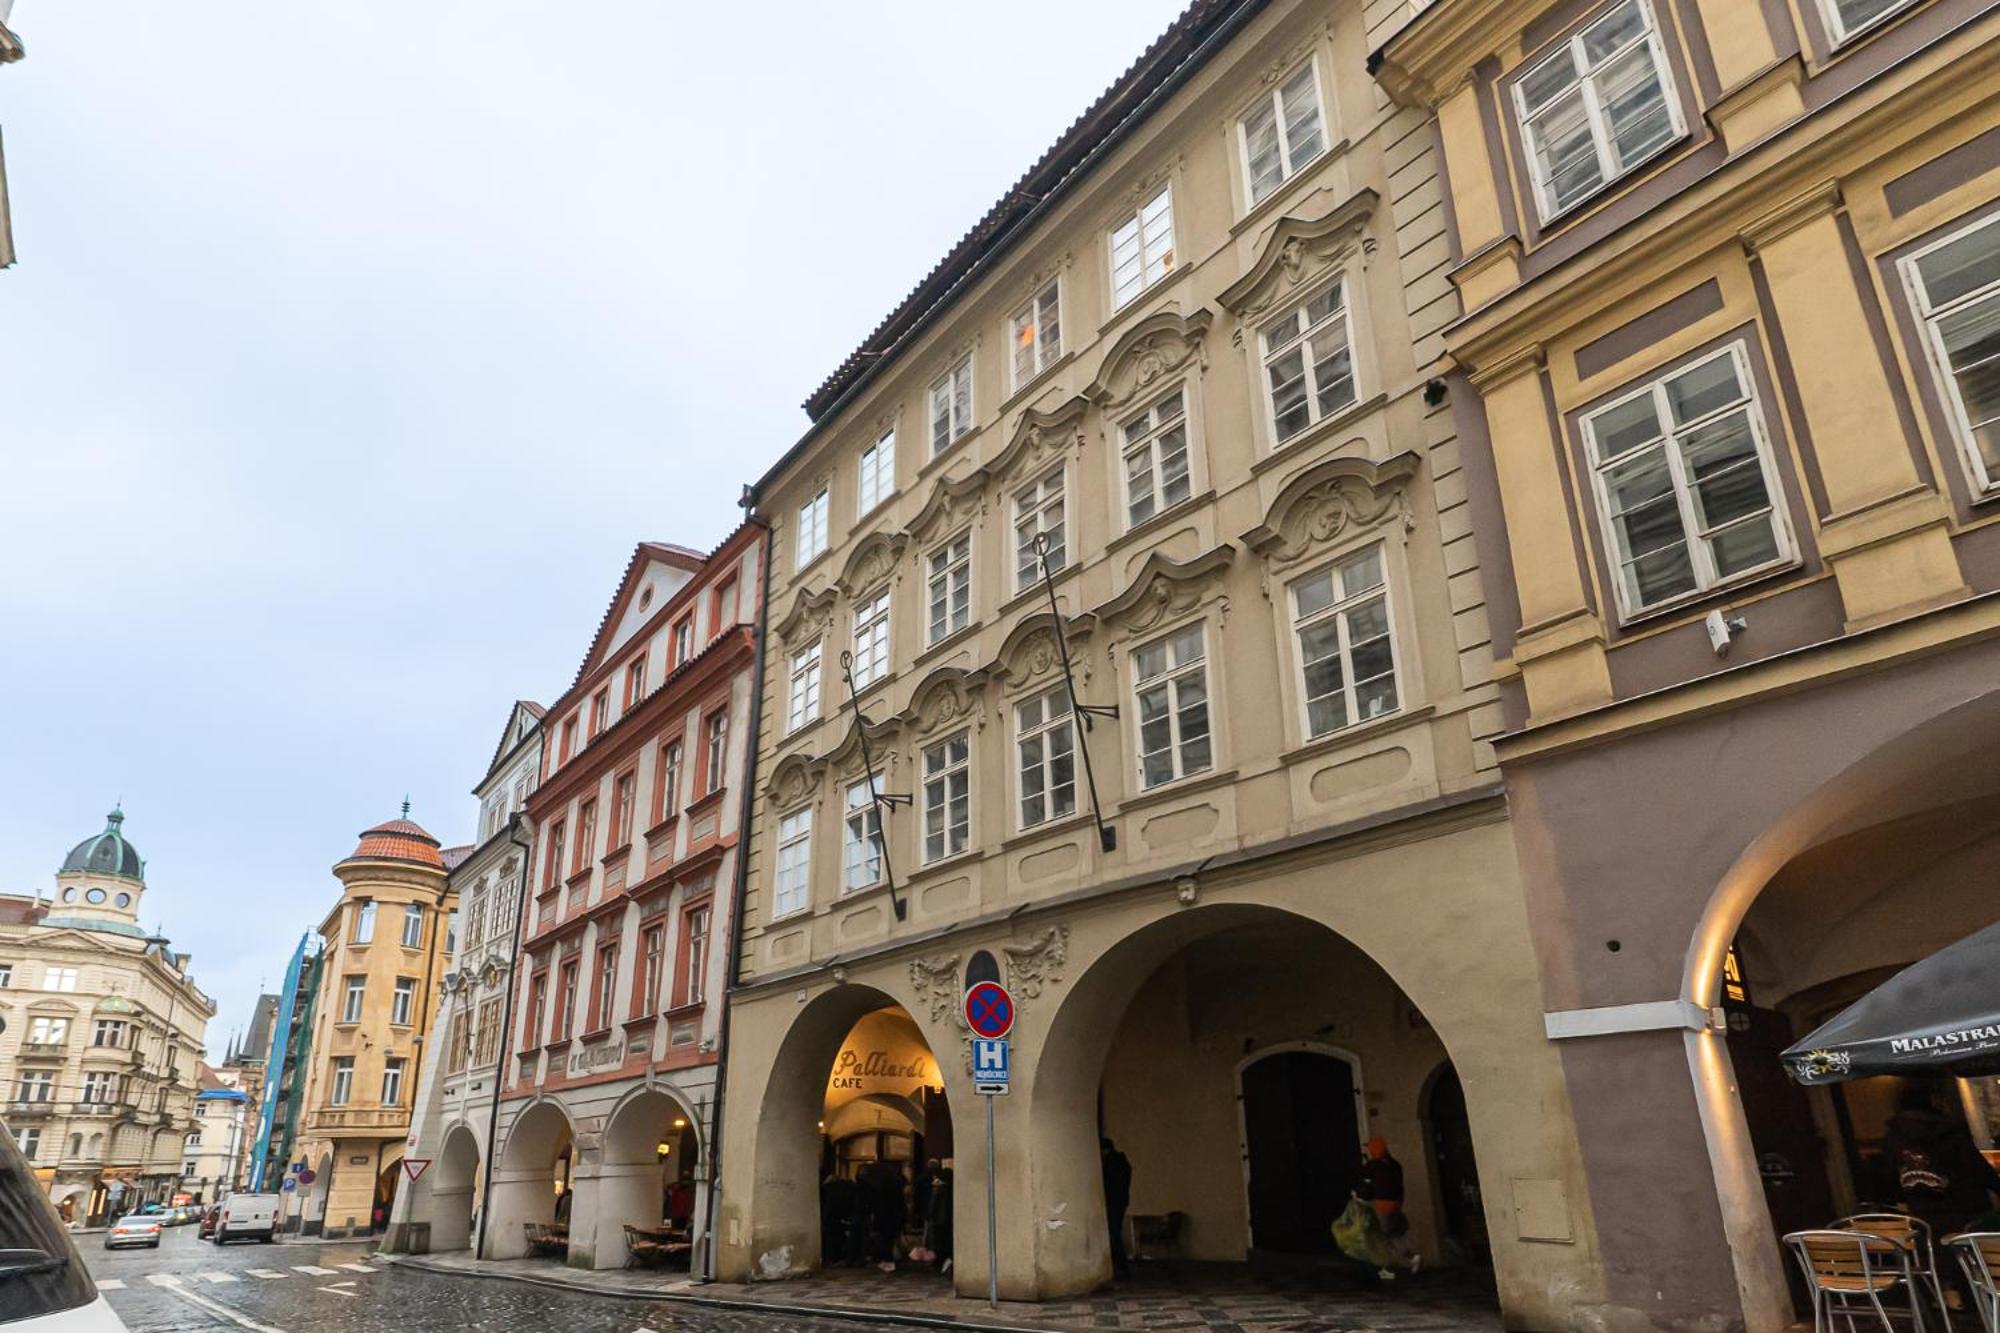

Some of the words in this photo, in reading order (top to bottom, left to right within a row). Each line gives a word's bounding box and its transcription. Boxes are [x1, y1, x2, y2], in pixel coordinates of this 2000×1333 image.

[1891, 1024, 2000, 1054] MALASTRA
[980, 1042, 1003, 1068] H
[833, 1078, 863, 1089] CAFE
